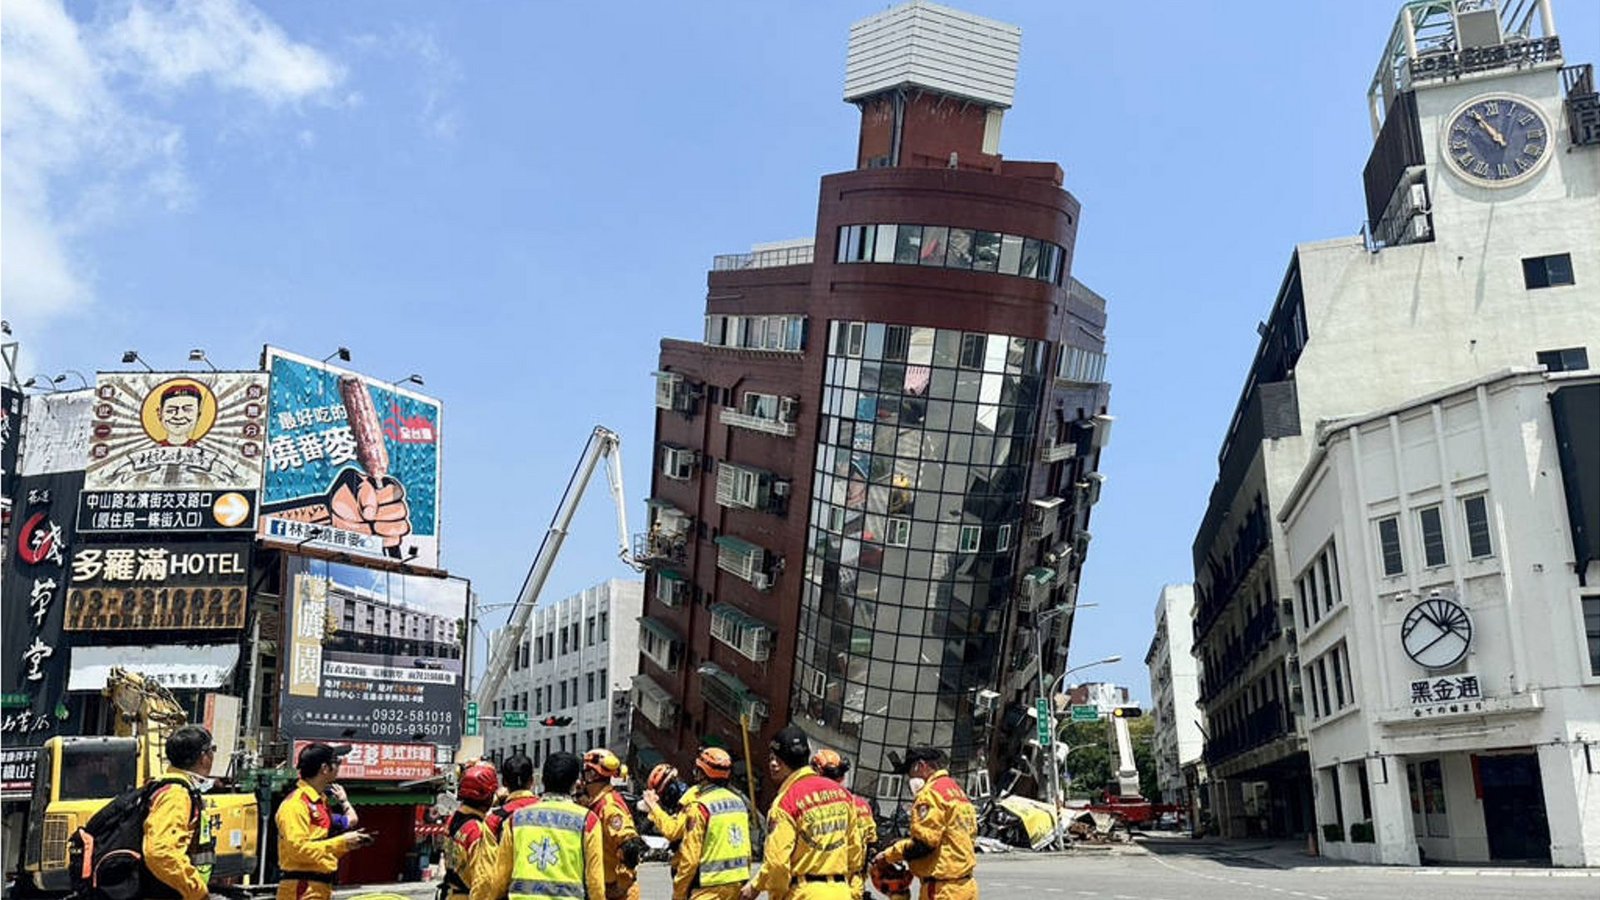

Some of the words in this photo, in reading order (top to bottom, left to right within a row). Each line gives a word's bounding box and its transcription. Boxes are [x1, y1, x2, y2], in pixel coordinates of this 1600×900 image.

[278, 405, 348, 430] 最好吃的
[265, 426, 359, 472] 燒番麥
[86, 492, 212, 509] 中山路北濱街交叉路口
[92, 511, 203, 529] (原住民一條街入口)
[72, 549, 170, 582] 多羅滿
[170, 554, 246, 575] HOTEL
[1411, 676, 1480, 704] 黑金通
[372, 708, 453, 723] 0932-581018
[371, 722, 452, 737] 0905-935071
